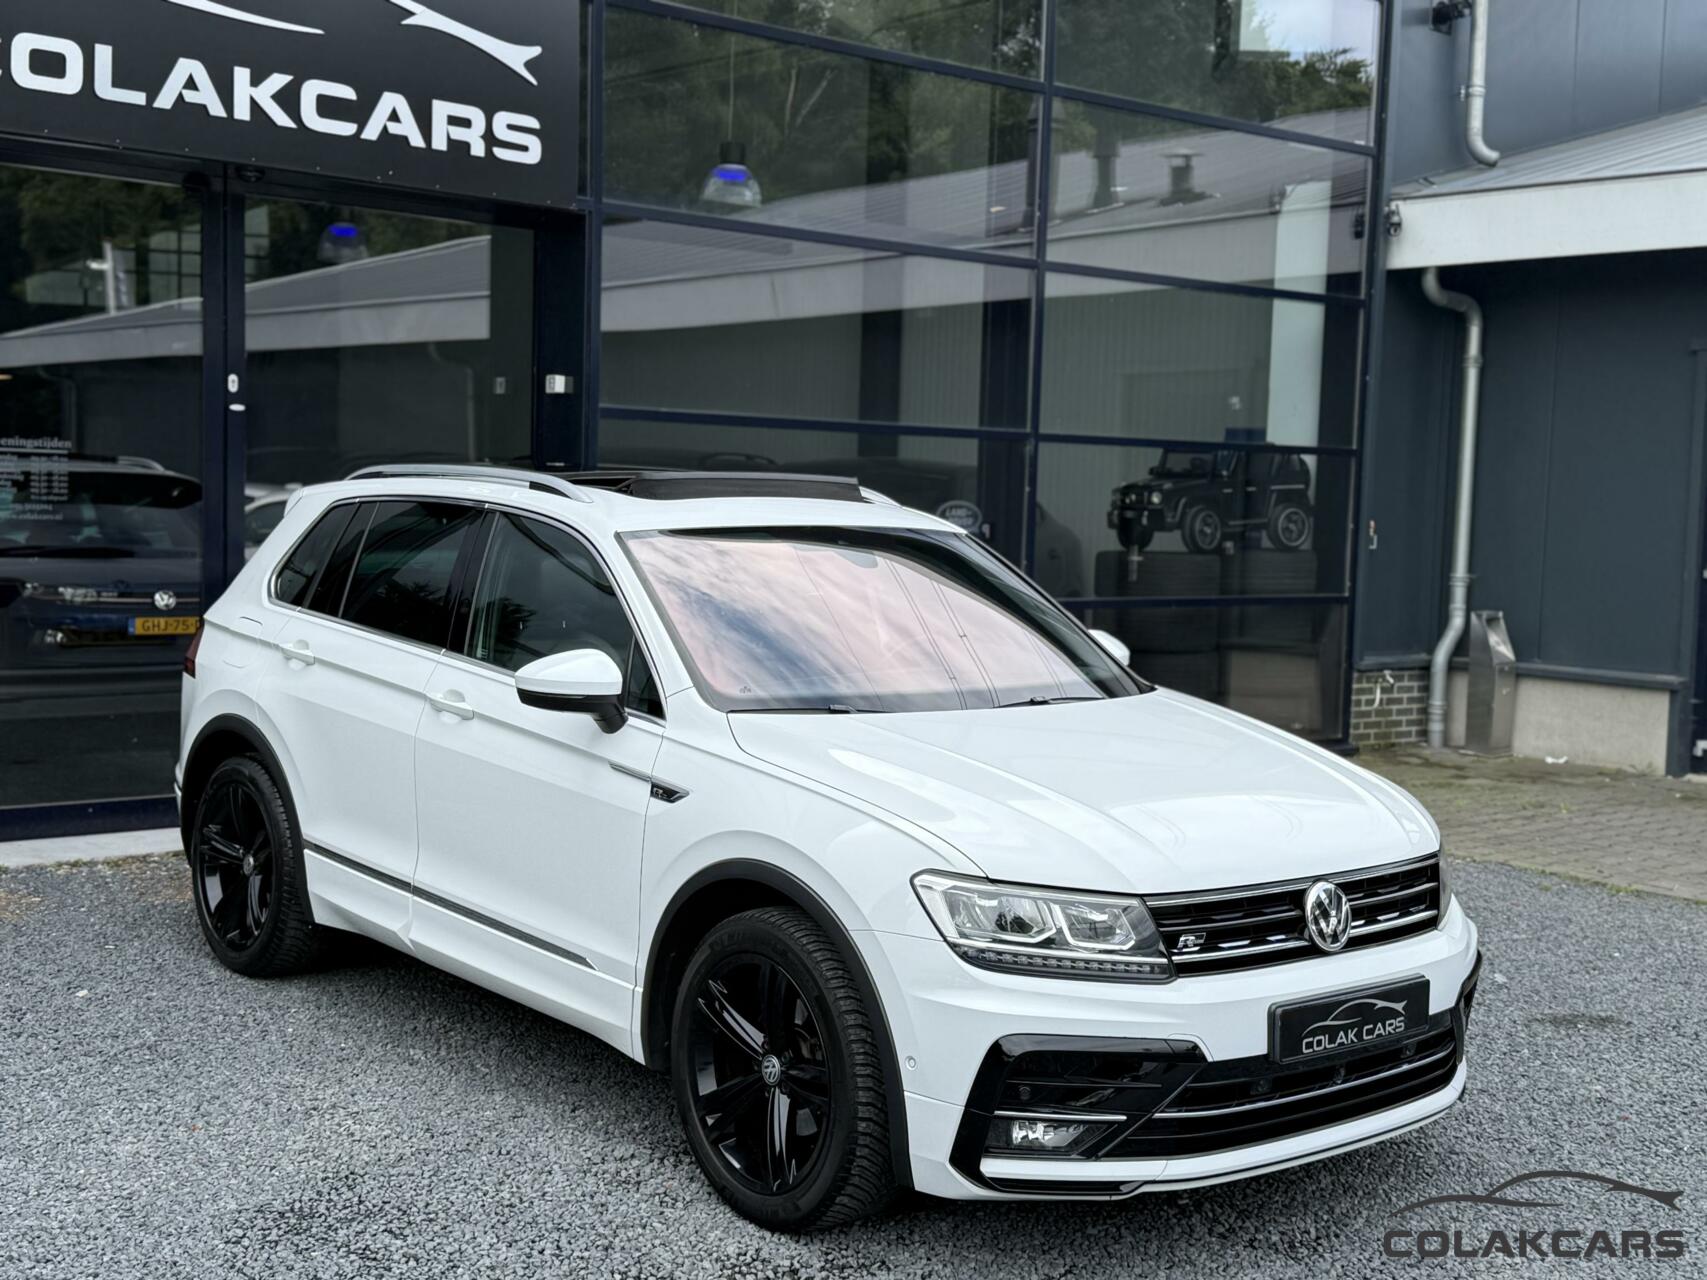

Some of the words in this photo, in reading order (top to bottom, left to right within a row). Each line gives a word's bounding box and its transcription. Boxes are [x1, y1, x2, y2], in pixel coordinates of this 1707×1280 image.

[0, 32, 543, 165] OLAKCARS
[1302, 1027, 1359, 1054] COLAK
[1363, 1016, 1405, 1040] CARS
